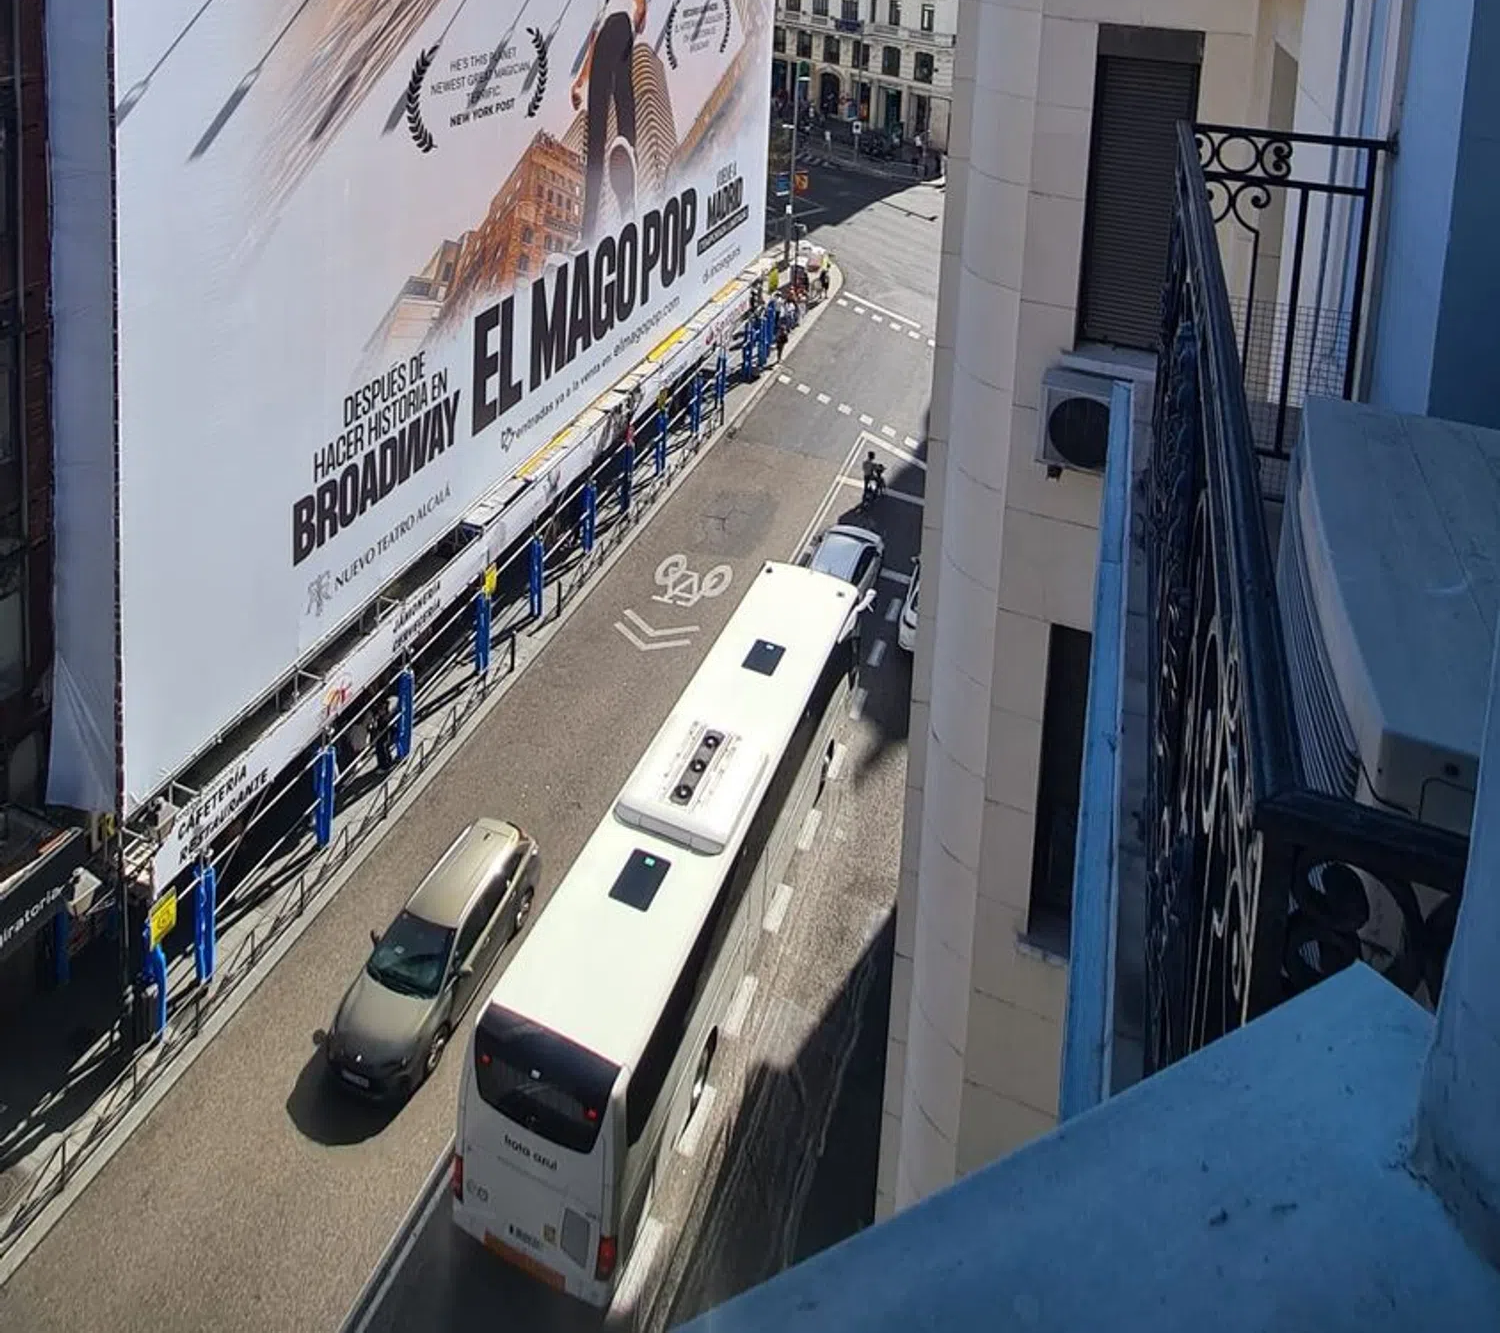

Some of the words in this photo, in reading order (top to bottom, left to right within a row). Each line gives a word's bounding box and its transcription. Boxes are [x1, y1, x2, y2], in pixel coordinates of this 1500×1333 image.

[449, 112, 470, 128] NEW
[472, 105, 494, 121] YORK
[495, 98, 515, 114] POST
[706, 175, 743, 230] MADRID
[472, 294, 523, 437] EL
[529, 222, 638, 393] MAGO
[640, 187, 698, 307] POP
[344, 361, 407, 427] DESPUÉS
[409, 351, 425, 385] DE
[515, 400, 554, 439] entradas
[580, 363, 600, 385] venta
[613, 296, 681, 358] elmagopop.com
[313, 423, 364, 483] HACER
[367, 381, 428, 446] HISTORIA
[431, 367, 447, 402] EN
[293, 389, 461, 567] BROADWAY
[334, 547, 376, 592] NUEVO
[376, 515, 416, 555] TEATRO
[177, 763, 248, 841] CAFETERÍA
[178, 767, 269, 865] RESTAURANTE
